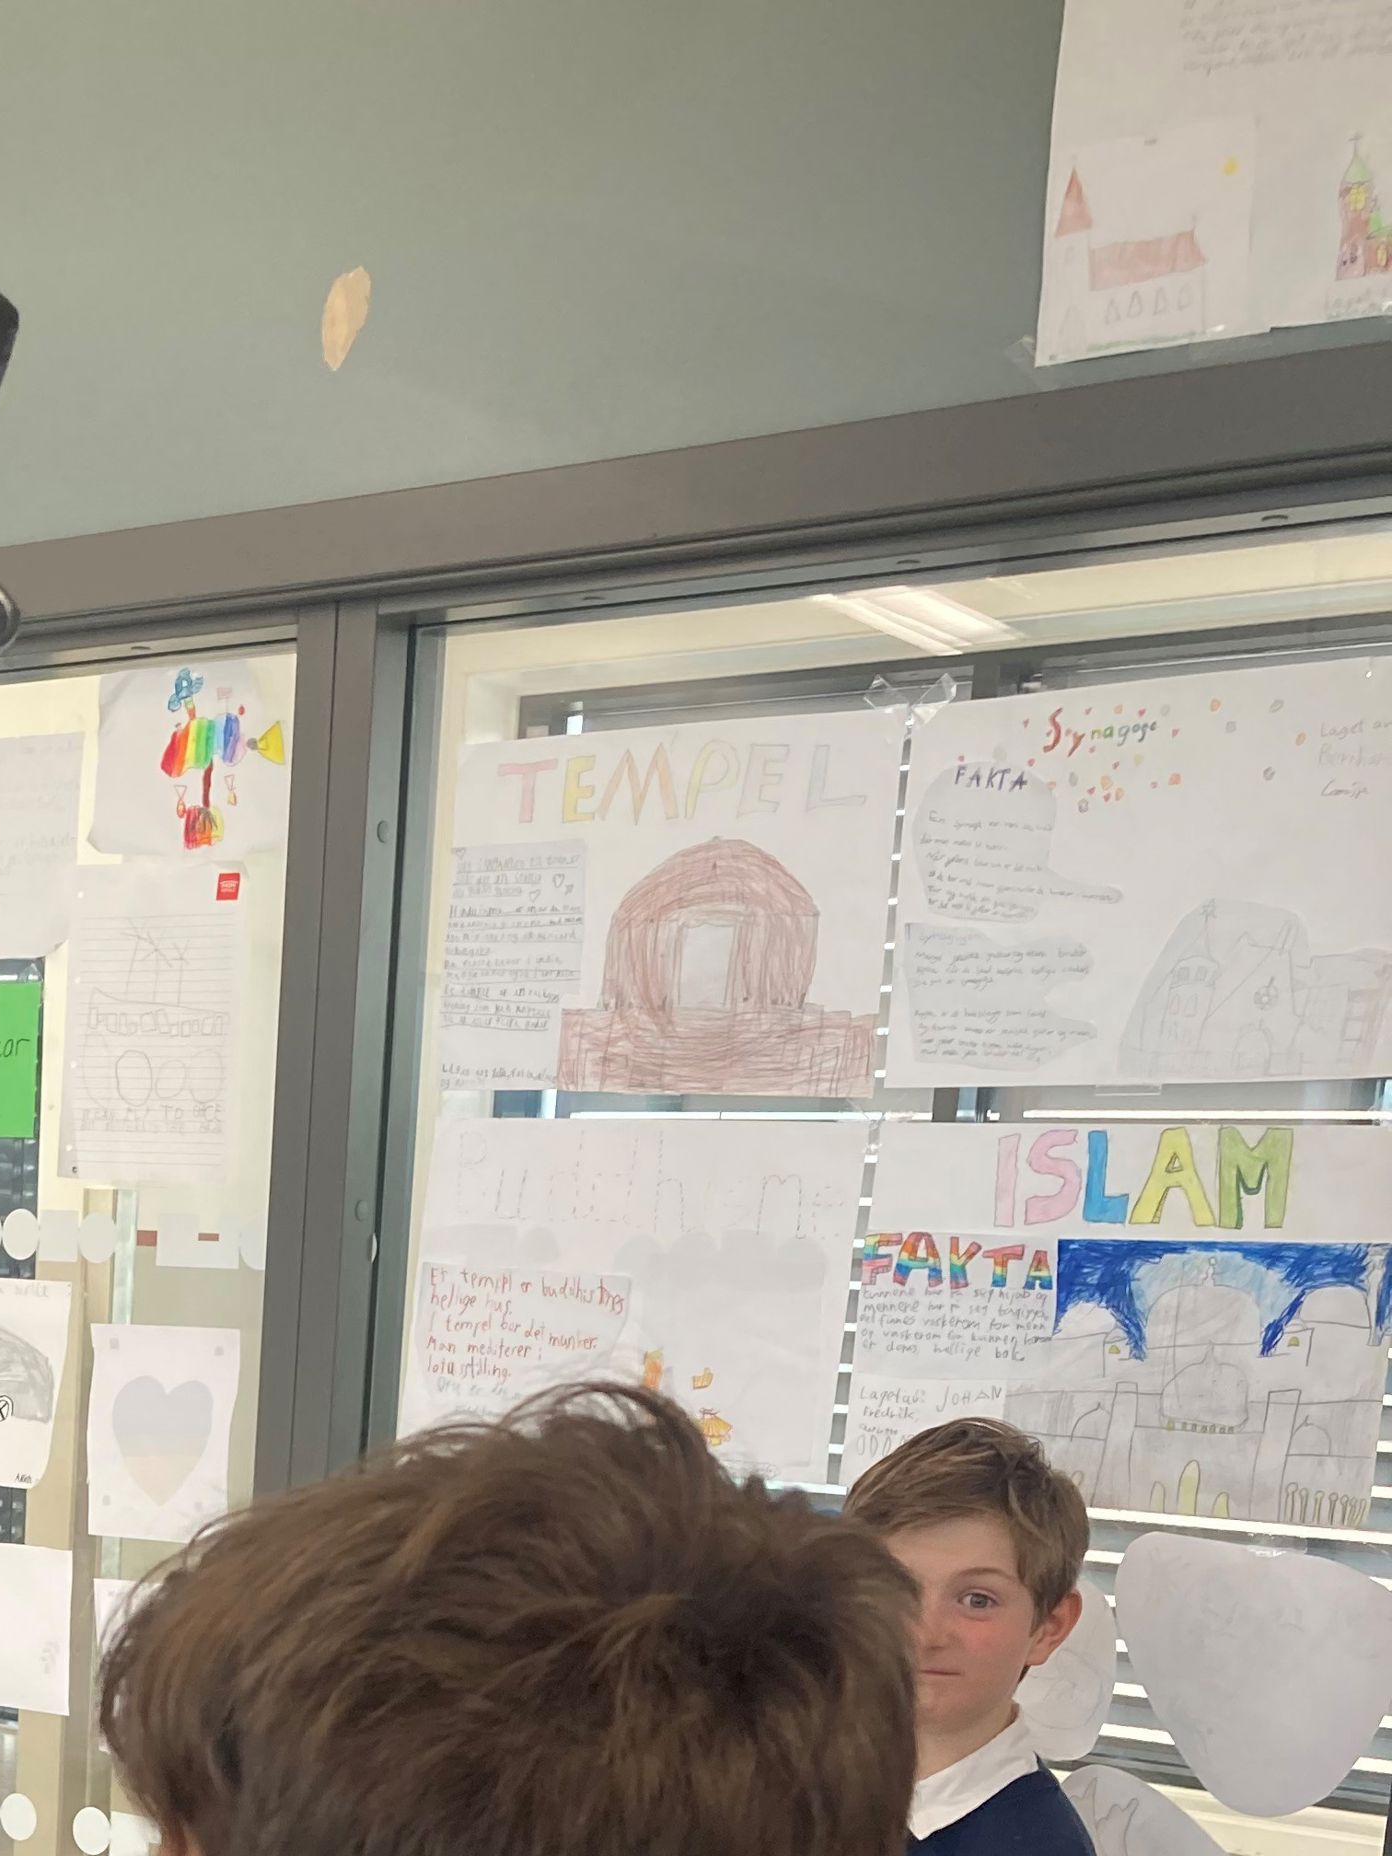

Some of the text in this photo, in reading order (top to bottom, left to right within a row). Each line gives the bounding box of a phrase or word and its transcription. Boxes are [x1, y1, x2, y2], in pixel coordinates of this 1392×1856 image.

[497, 739, 867, 826] TEMPEL
[954, 764, 1028, 792] FAKTA
[994, 1127, 1294, 1229] ISLAM
[936, 1384, 1002, 1413] JOHAN
